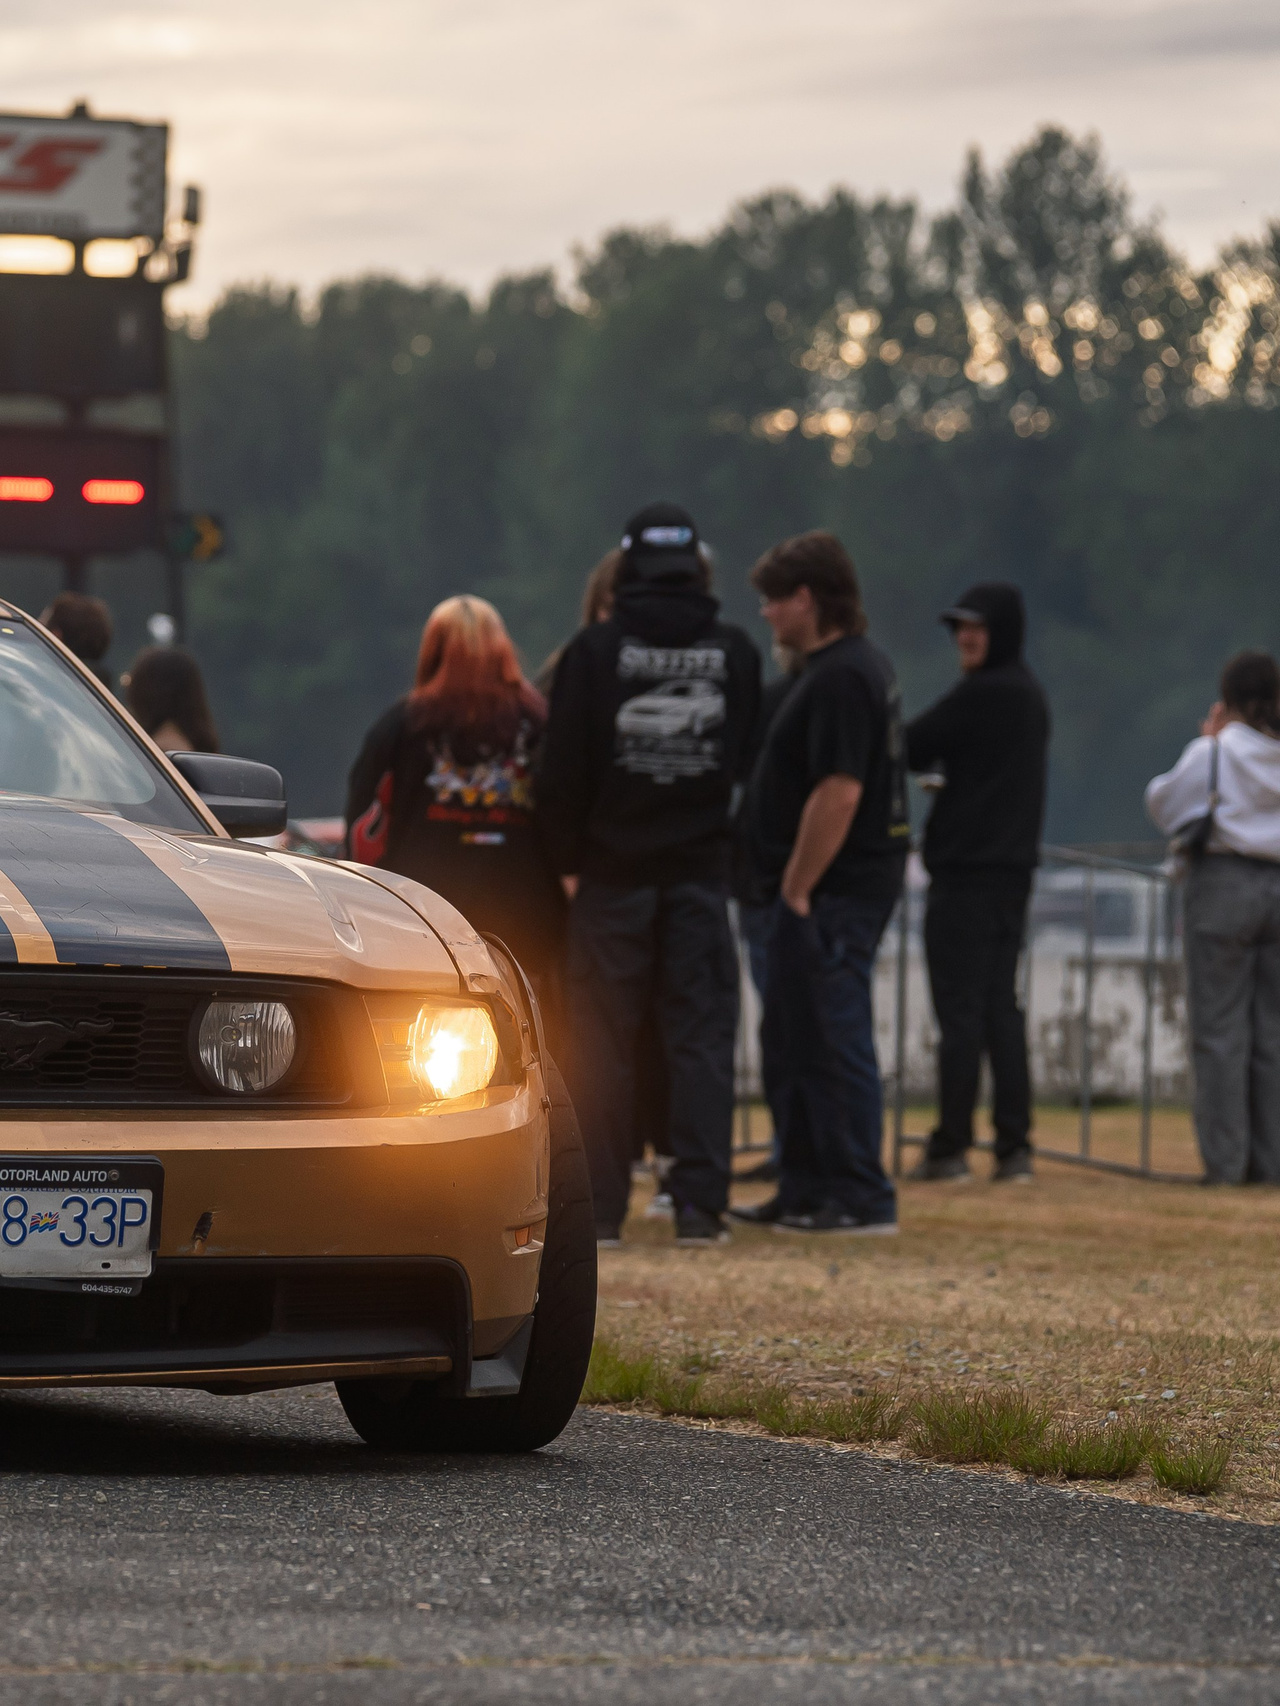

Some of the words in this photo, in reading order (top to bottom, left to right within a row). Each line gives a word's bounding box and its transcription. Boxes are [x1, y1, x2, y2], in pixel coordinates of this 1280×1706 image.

[72, 1170, 108, 1182] AUTO
[59, 1195, 148, 1248] 33P
[81, 1283, 133, 1295] 604-435-5747
